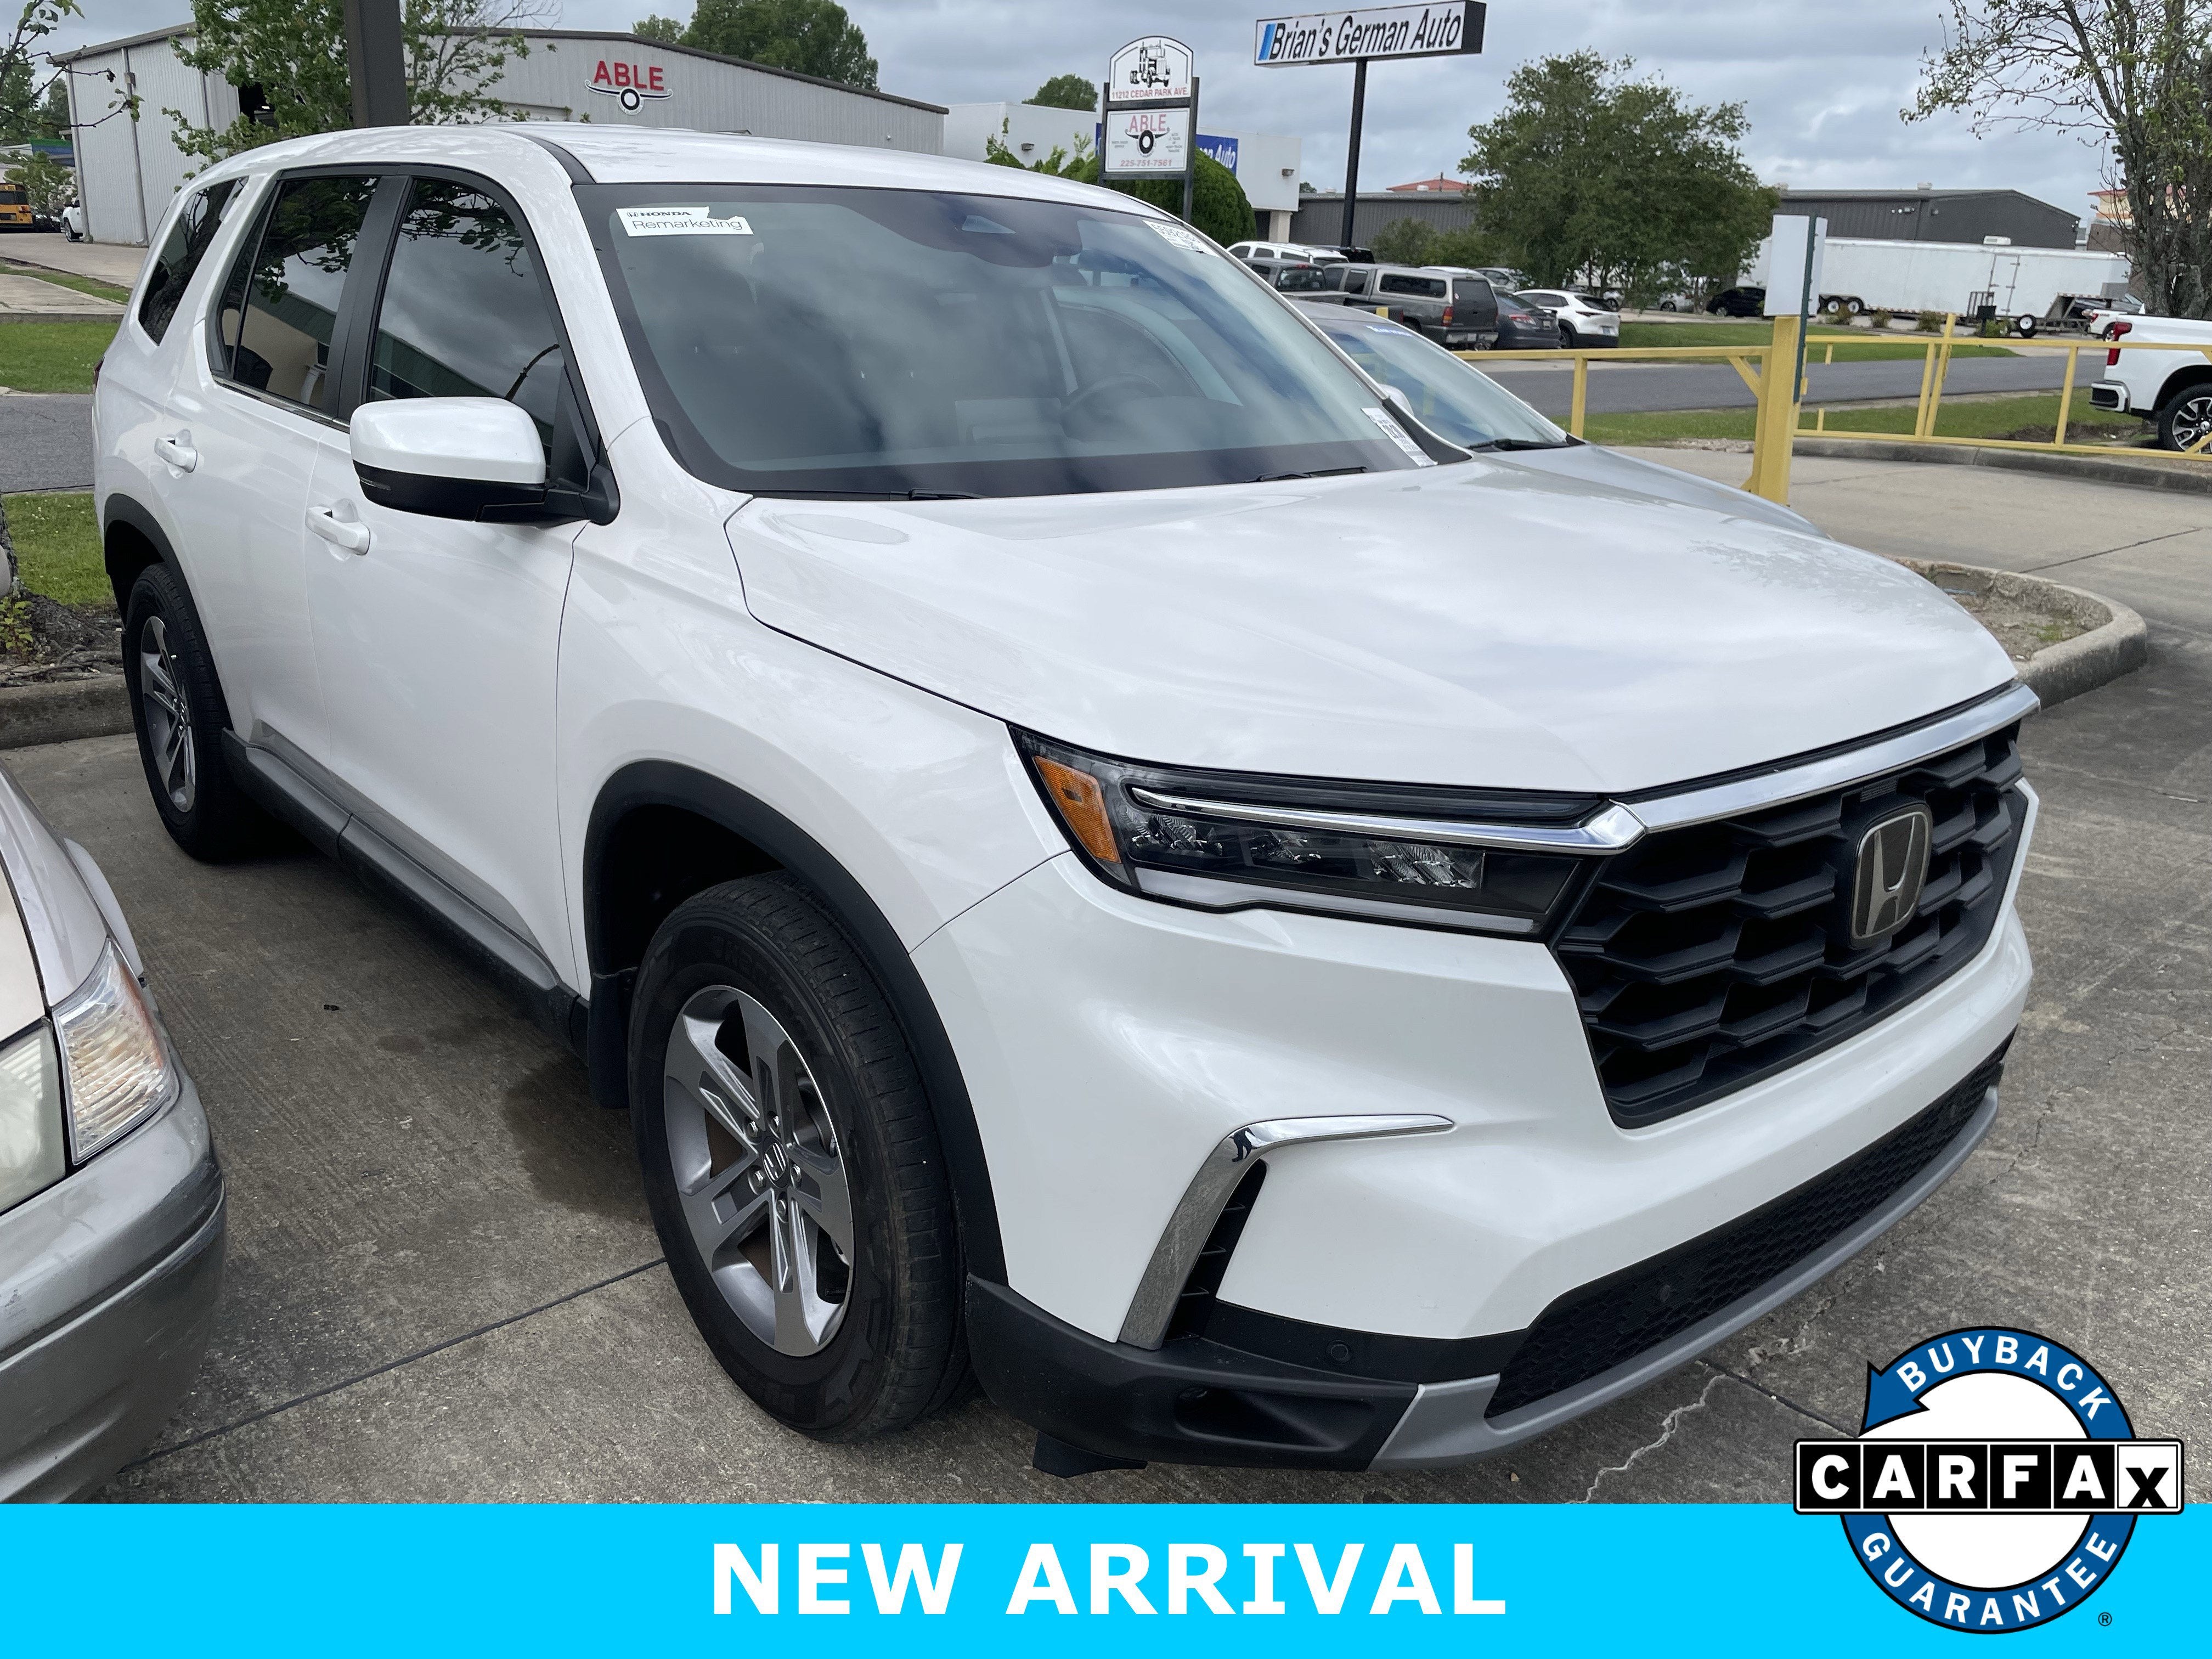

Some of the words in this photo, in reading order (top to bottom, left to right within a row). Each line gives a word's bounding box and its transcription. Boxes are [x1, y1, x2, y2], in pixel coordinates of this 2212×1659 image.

[1269, 19, 1332, 60] Brian's
[1335, 15, 1410, 56] German
[1410, 8, 1462, 49] Auto
[594, 60, 664, 91] ABLE
[1111, 90, 1128, 99] 11212
[1130, 88, 1153, 98] CEDAR
[1154, 87, 1172, 97] PARK
[1173, 87, 1189, 95] AVE.
[1129, 114, 1167, 132] ABLE
[1215, 144, 1236, 168] Auto
[632, 219, 743, 230] Remarketing
